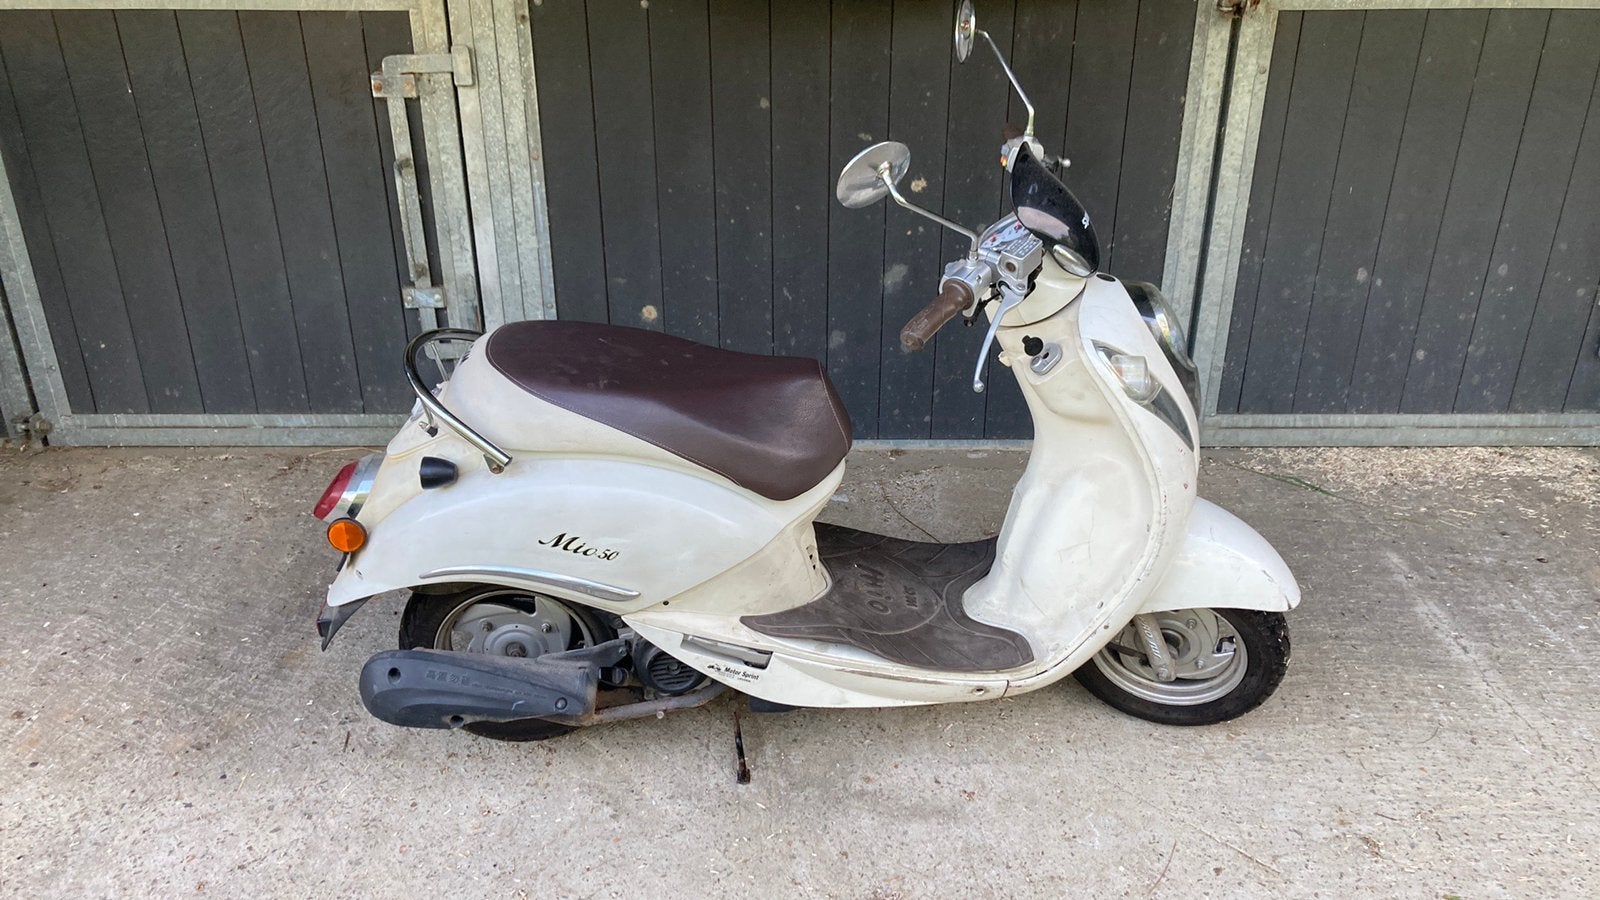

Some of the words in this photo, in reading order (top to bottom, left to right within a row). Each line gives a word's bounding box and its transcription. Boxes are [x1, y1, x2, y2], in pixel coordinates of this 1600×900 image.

[538, 532, 598, 557] Mio
[598, 548, 620, 561] 50
[724, 666, 741, 675] Motor
[742, 670, 760, 681] Sprint
